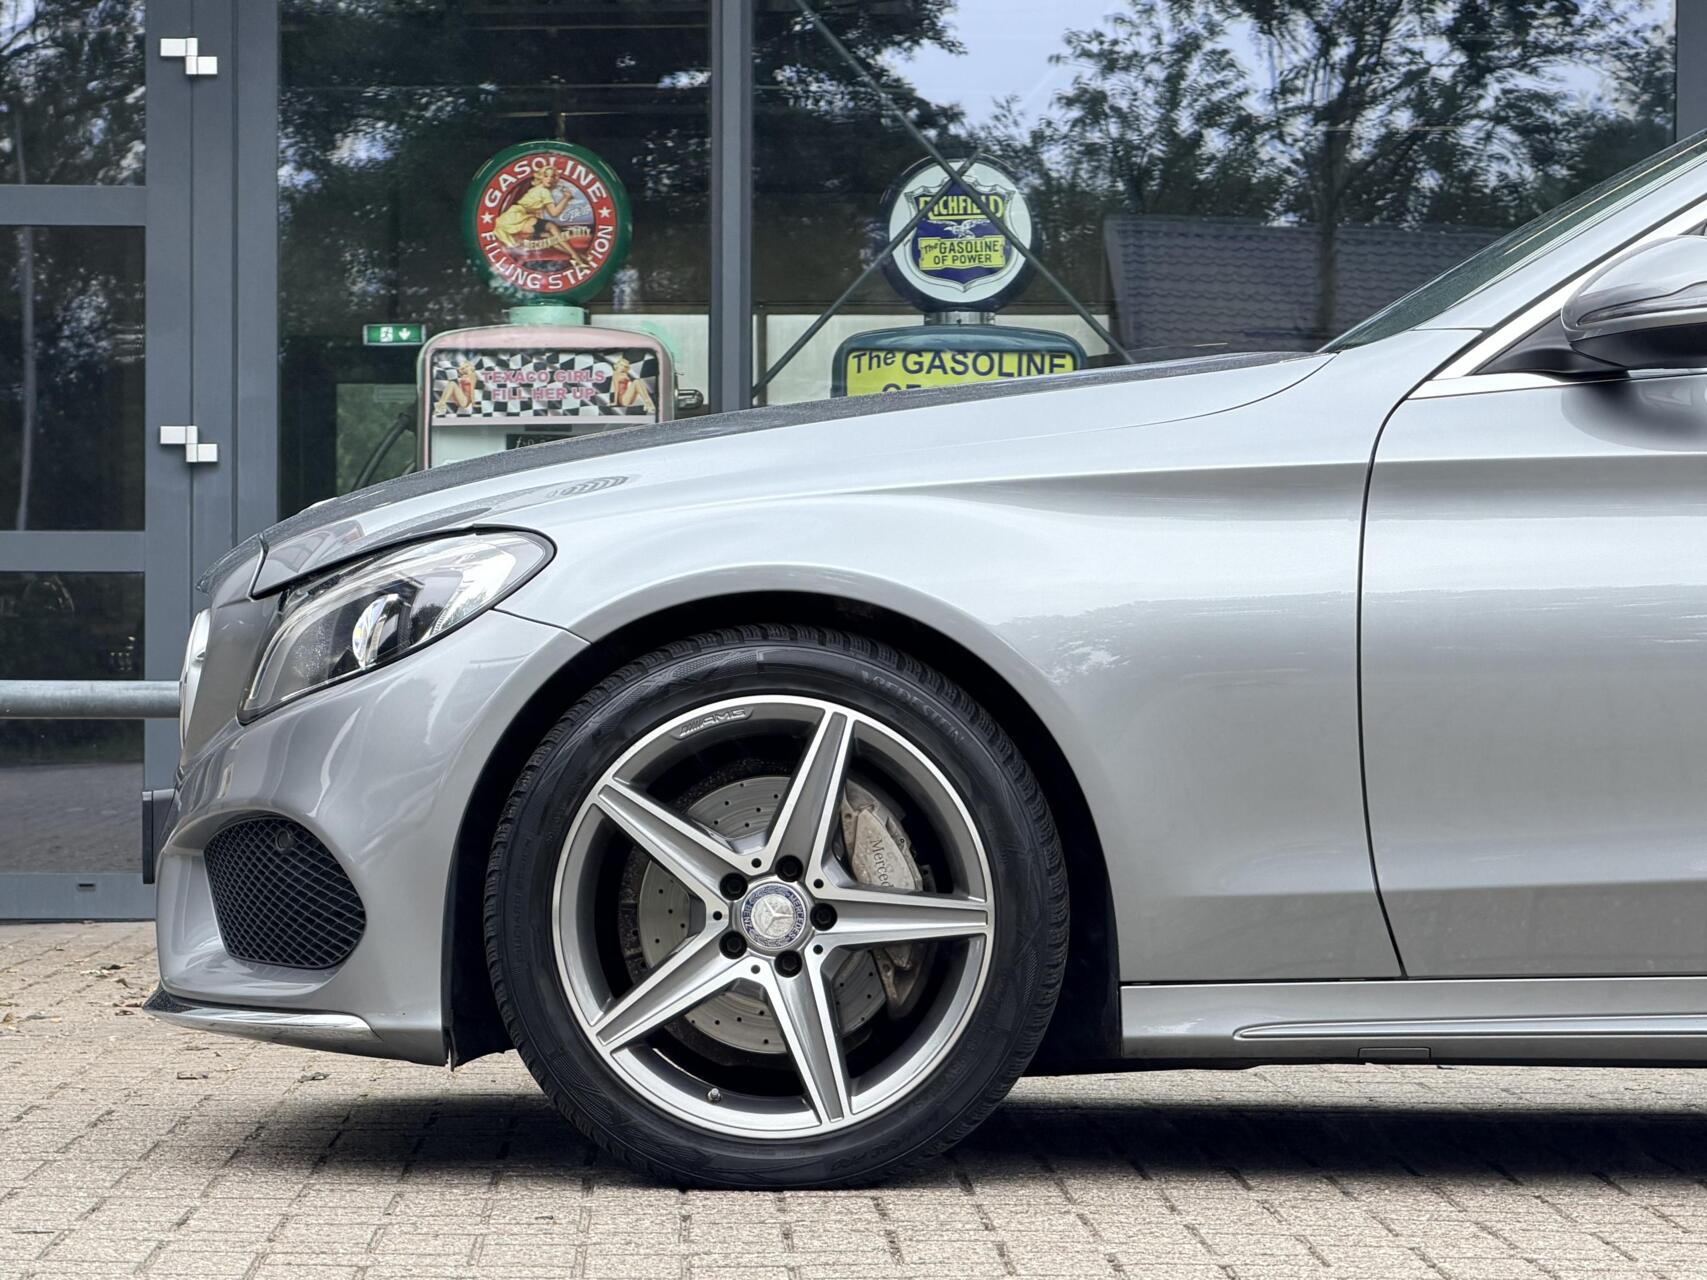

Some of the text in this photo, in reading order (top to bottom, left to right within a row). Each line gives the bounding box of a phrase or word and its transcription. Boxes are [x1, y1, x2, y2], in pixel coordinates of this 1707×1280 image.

[484, 157, 607, 208] GASOLINE
[939, 240, 999, 254] GASOLINE
[481, 225, 613, 289] FILLING STATION
[933, 253, 992, 265] OF POWER
[852, 351, 896, 373] The
[482, 370, 605, 383] TEXACO GIRLS
[492, 388, 597, 400] FILL HER UP
[788, 892, 804, 939] MERCEDES
